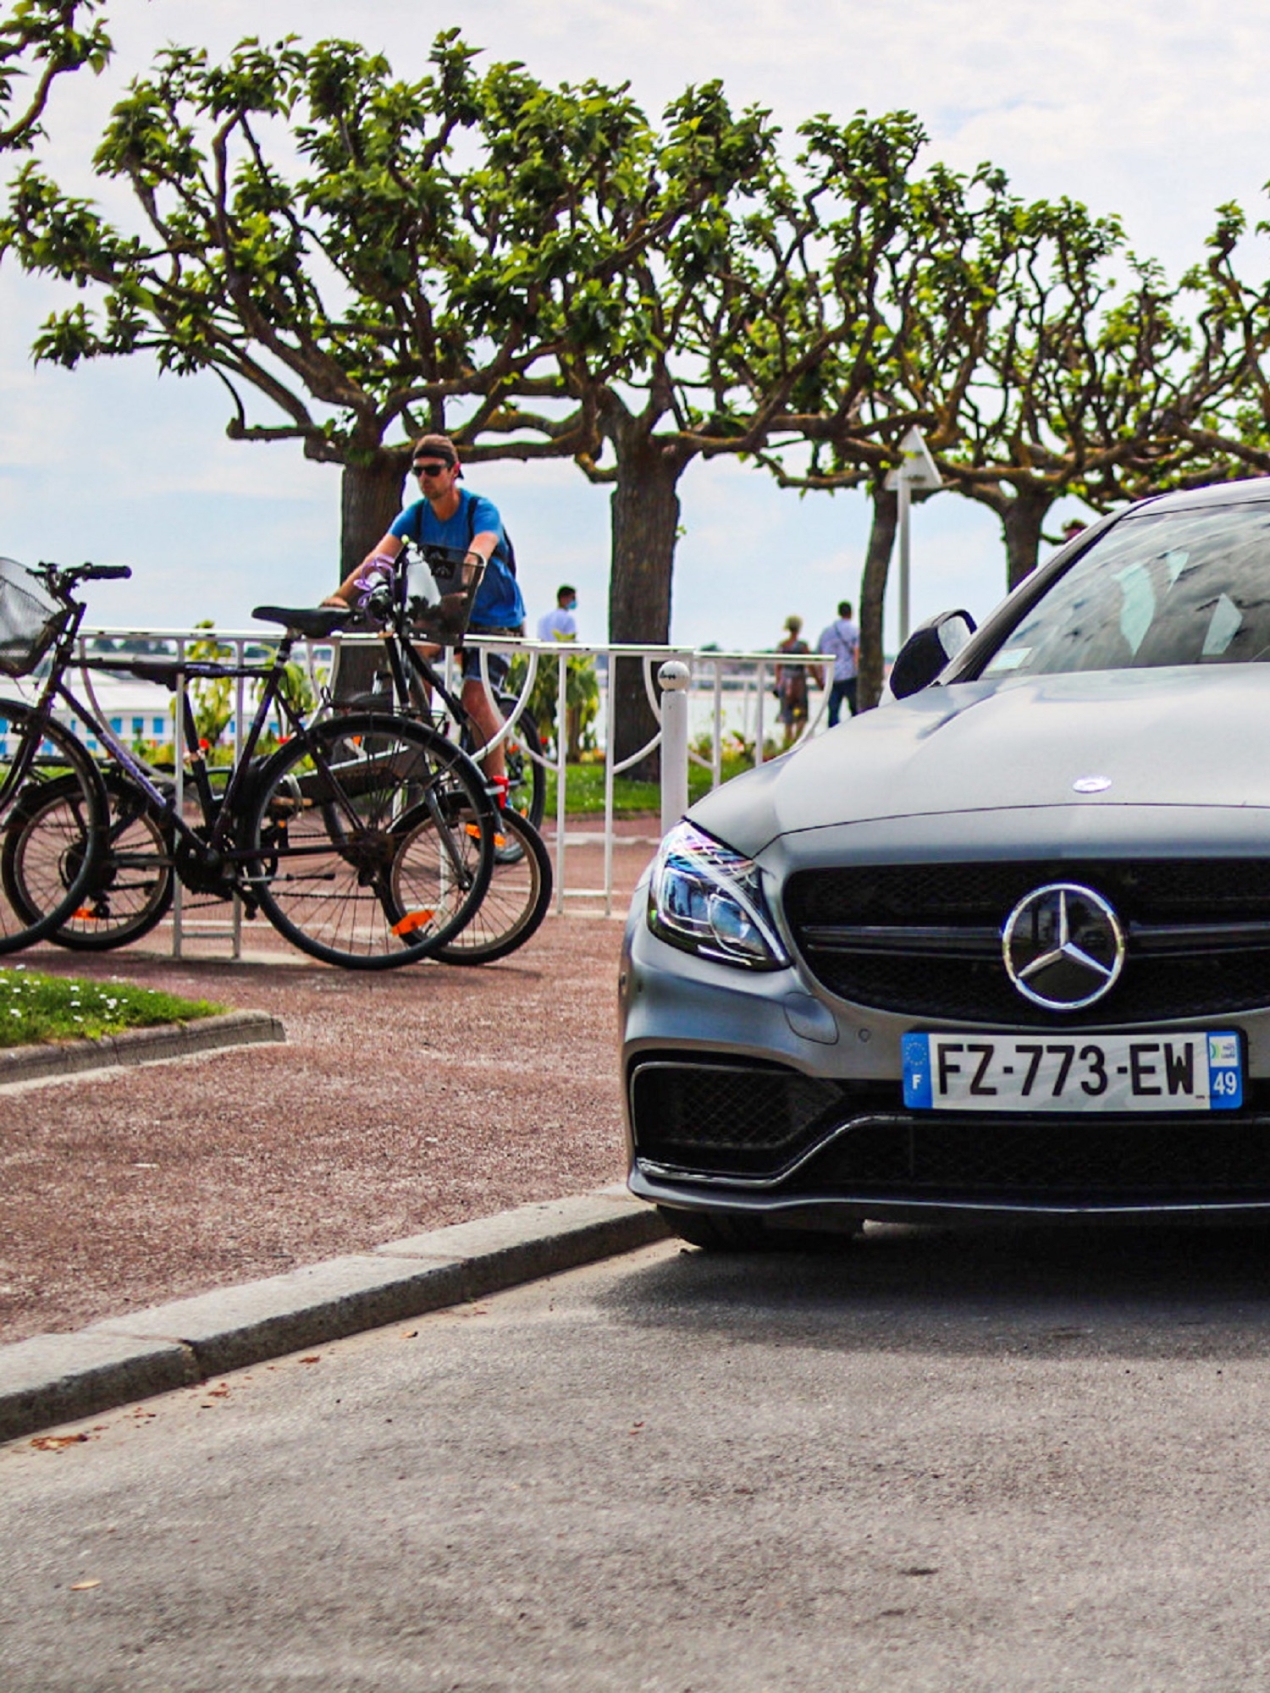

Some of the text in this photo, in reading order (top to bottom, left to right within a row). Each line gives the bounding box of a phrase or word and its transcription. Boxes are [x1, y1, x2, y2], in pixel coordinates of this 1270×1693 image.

[937, 1042, 1195, 1097] FZ-773-EW
[912, 1074, 921, 1089] F
[1213, 1072, 1237, 1095] 49
